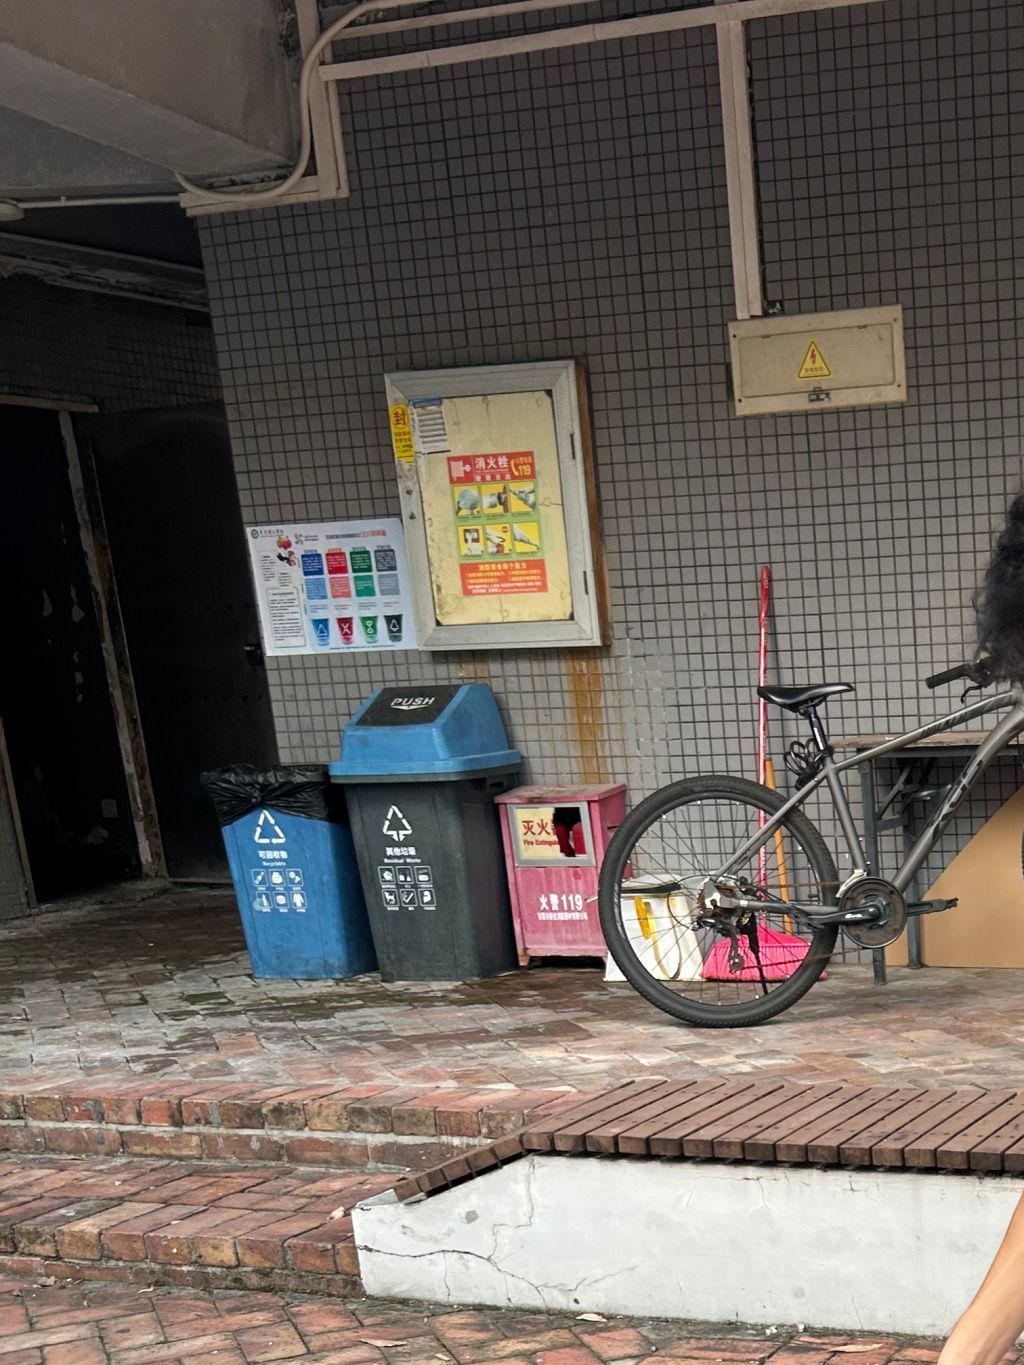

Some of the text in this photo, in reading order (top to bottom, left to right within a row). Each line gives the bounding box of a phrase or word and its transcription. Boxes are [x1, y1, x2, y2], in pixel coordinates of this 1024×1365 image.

[475, 455, 510, 470] 消火栓
[518, 465, 532, 476] 119
[390, 697, 436, 706] PUSH
[258, 850, 288, 860] 可回收物
[385, 847, 417, 857] 其他垃圾
[539, 893, 584, 911] 火警119
